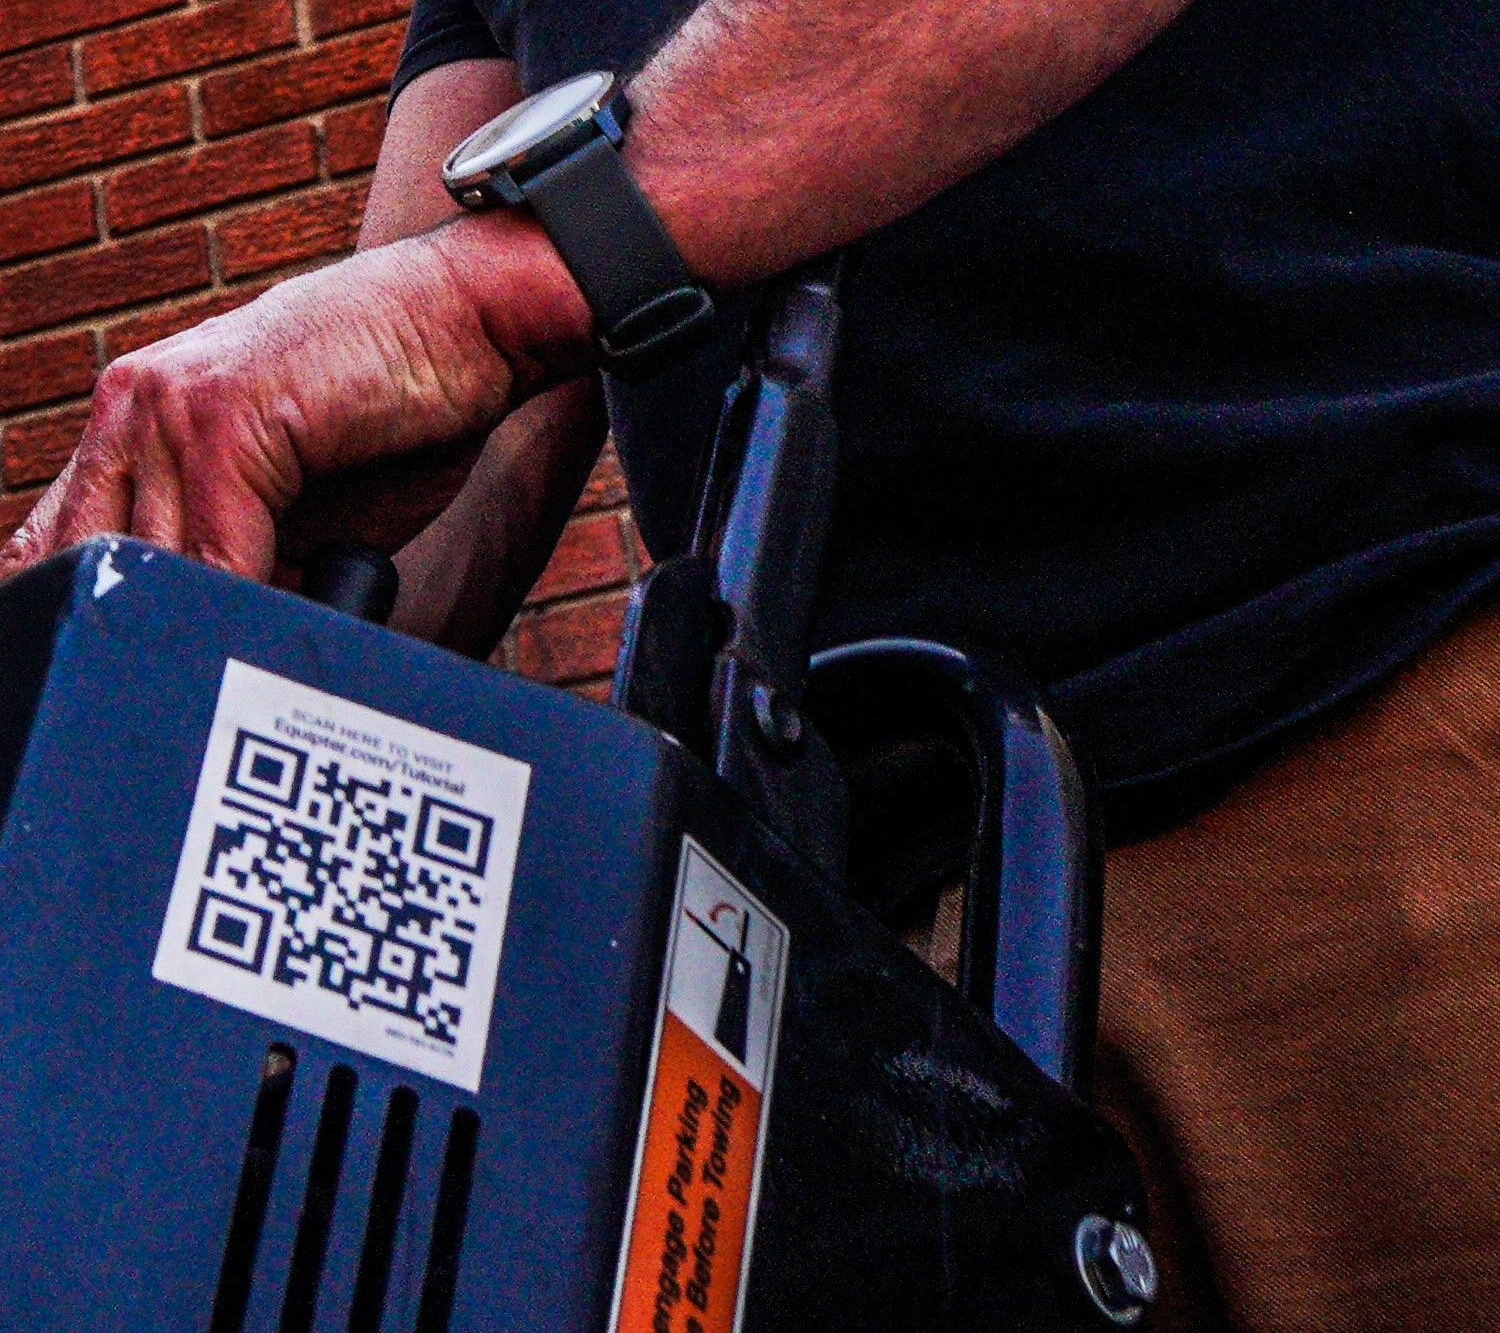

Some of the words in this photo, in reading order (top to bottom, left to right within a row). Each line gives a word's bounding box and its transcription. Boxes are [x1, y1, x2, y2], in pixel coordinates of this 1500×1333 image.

[273, 717, 466, 796] Equipter.com/Tutorial
[290, 708, 336, 733] SCAN
[339, 725, 381, 749] HERE
[387, 742, 409, 759] TO
[413, 751, 453, 774] VISIT
[666, 1077, 709, 1207] Parking
[702, 1074, 743, 1190] Towing
[653, 1210, 687, 1333] engage
[685, 1197, 721, 1312] Before
